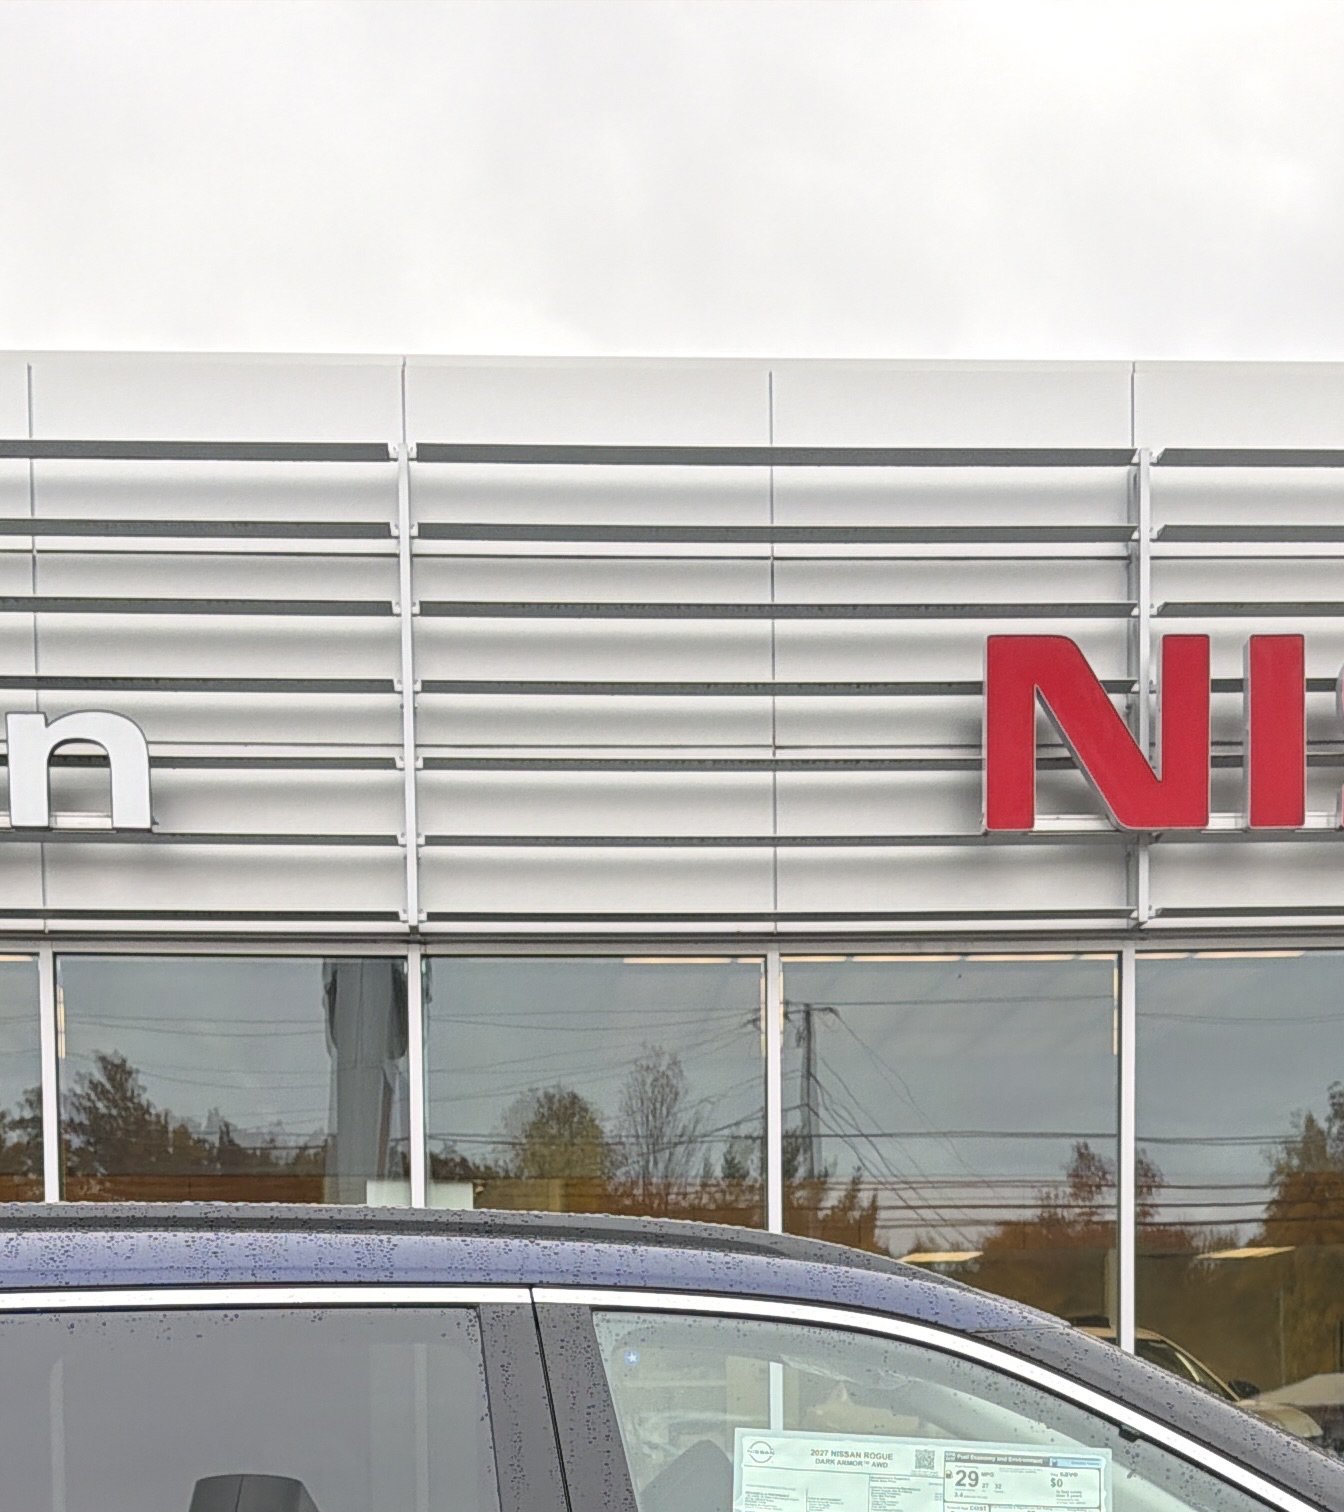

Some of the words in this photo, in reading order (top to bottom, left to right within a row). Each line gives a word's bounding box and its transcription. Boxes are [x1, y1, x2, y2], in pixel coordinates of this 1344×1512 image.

[810, 1449, 828, 1457] 2027
[831, 1450, 862, 1459] NISSAN
[863, 1452, 894, 1461] ROGUE
[871, 1461, 888, 1469] AWD
[955, 1470, 979, 1488] 29
[1050, 1478, 1063, 1488] $0
